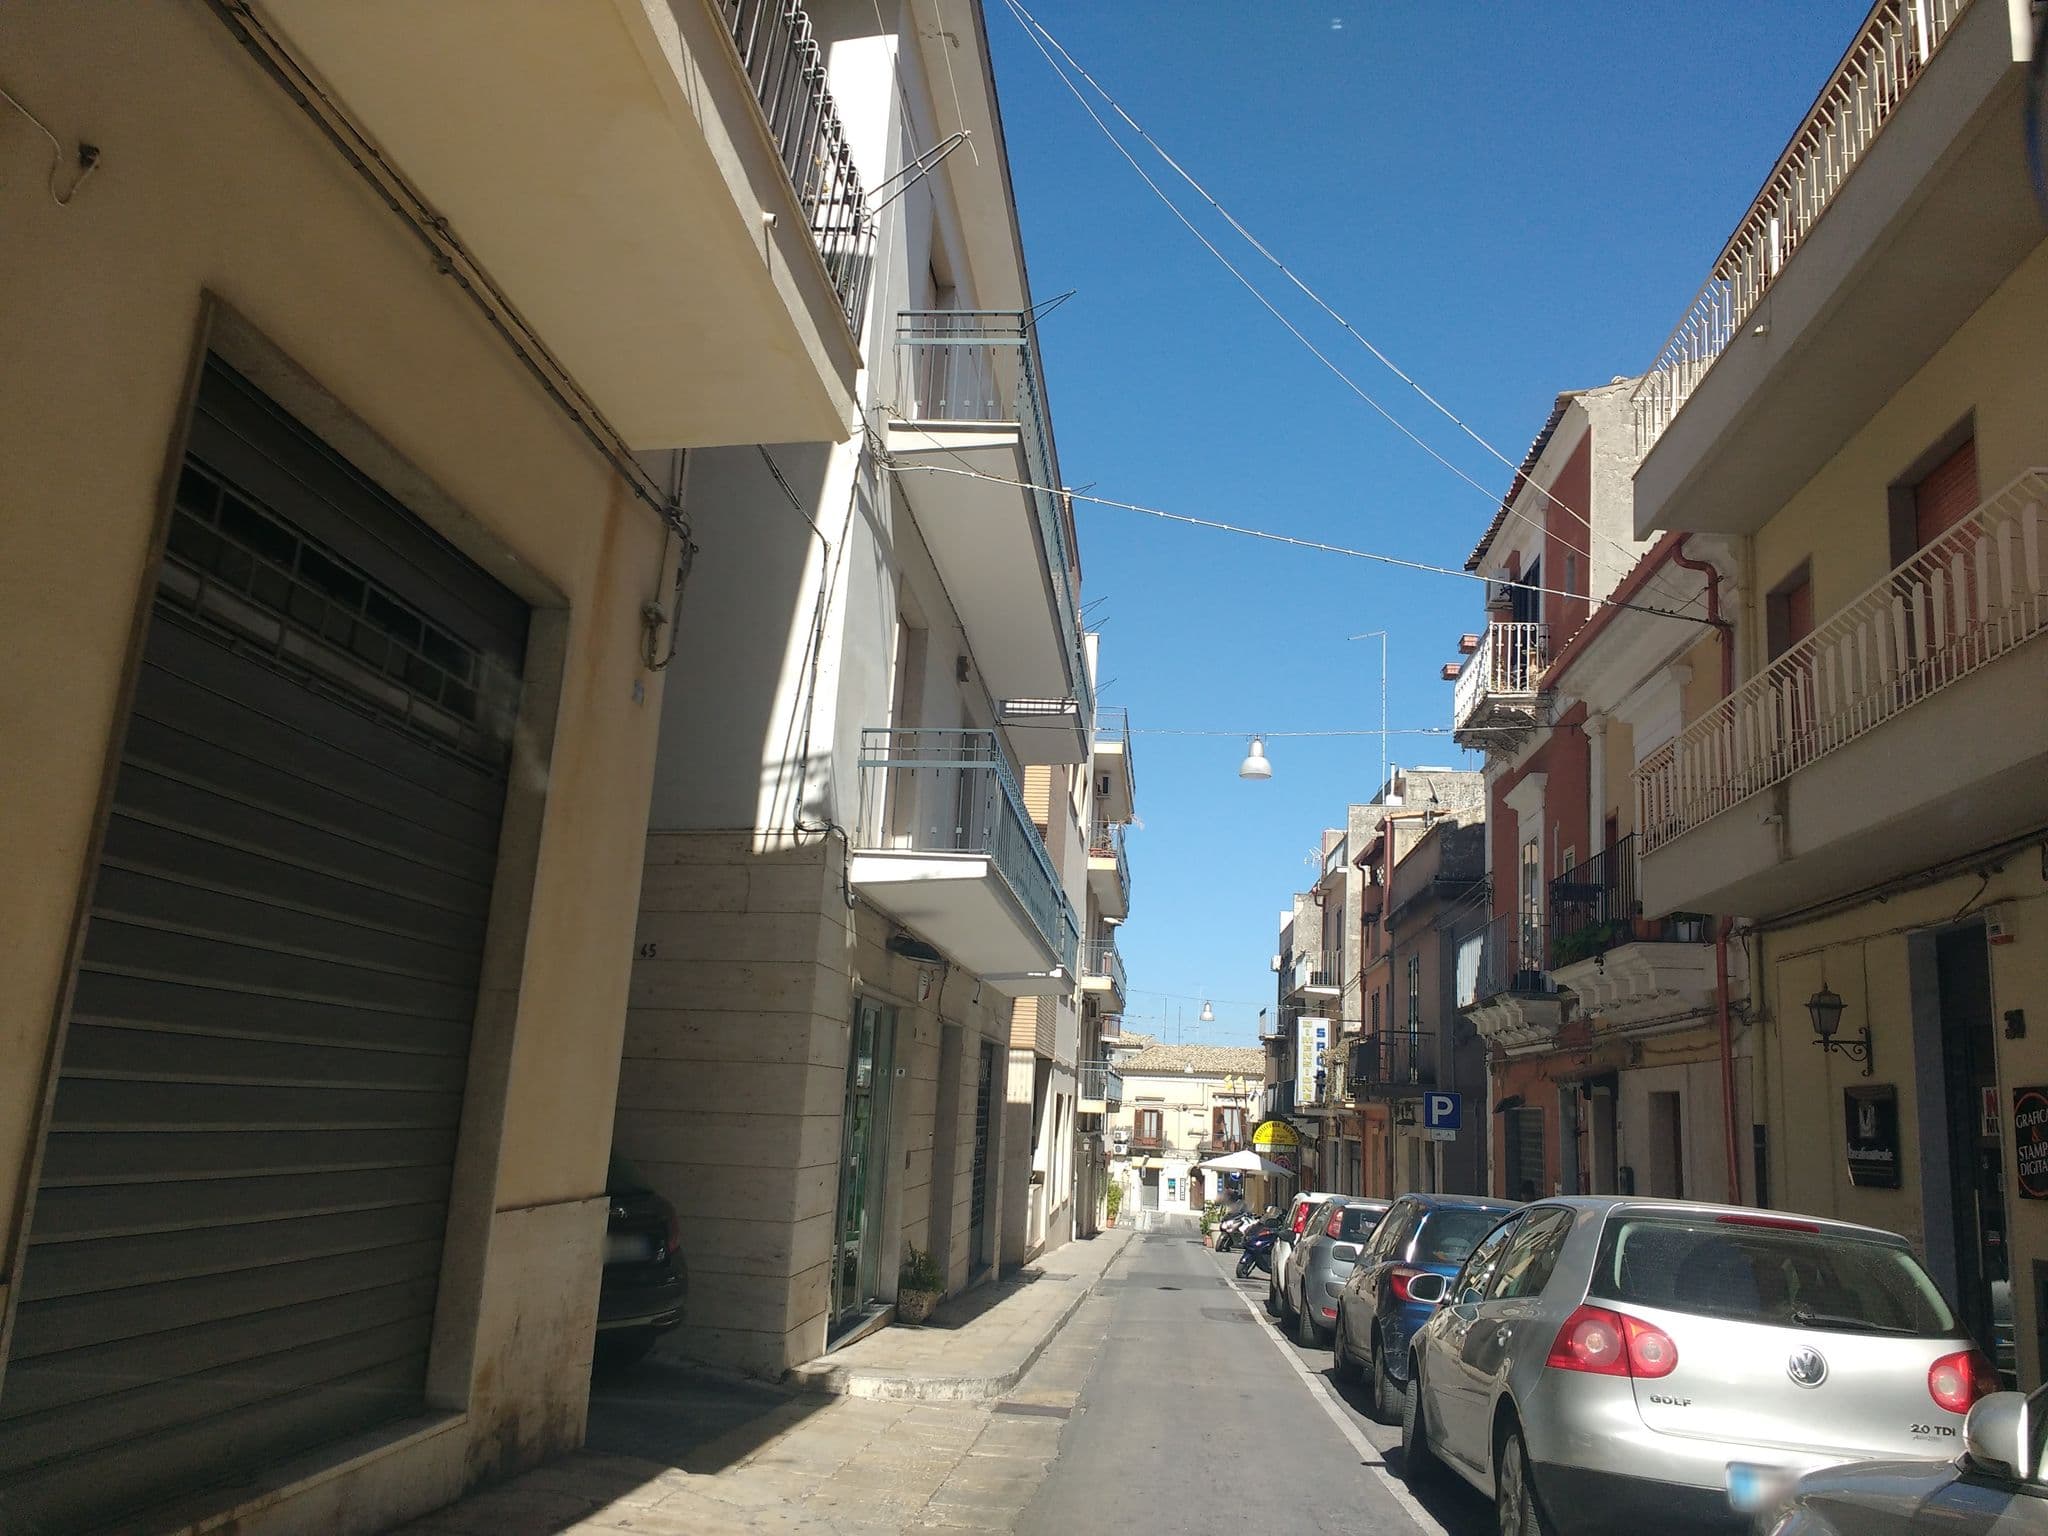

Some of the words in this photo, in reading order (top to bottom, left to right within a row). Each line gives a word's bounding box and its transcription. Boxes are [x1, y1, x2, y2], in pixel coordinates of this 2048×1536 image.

[641, 943, 657, 958] 45
[1431, 1095, 1454, 1125] P
[2018, 1141, 2048, 1162] STAMP
[1649, 1394, 1692, 1407] GOLF
[1934, 1425, 1956, 1437] TDI
